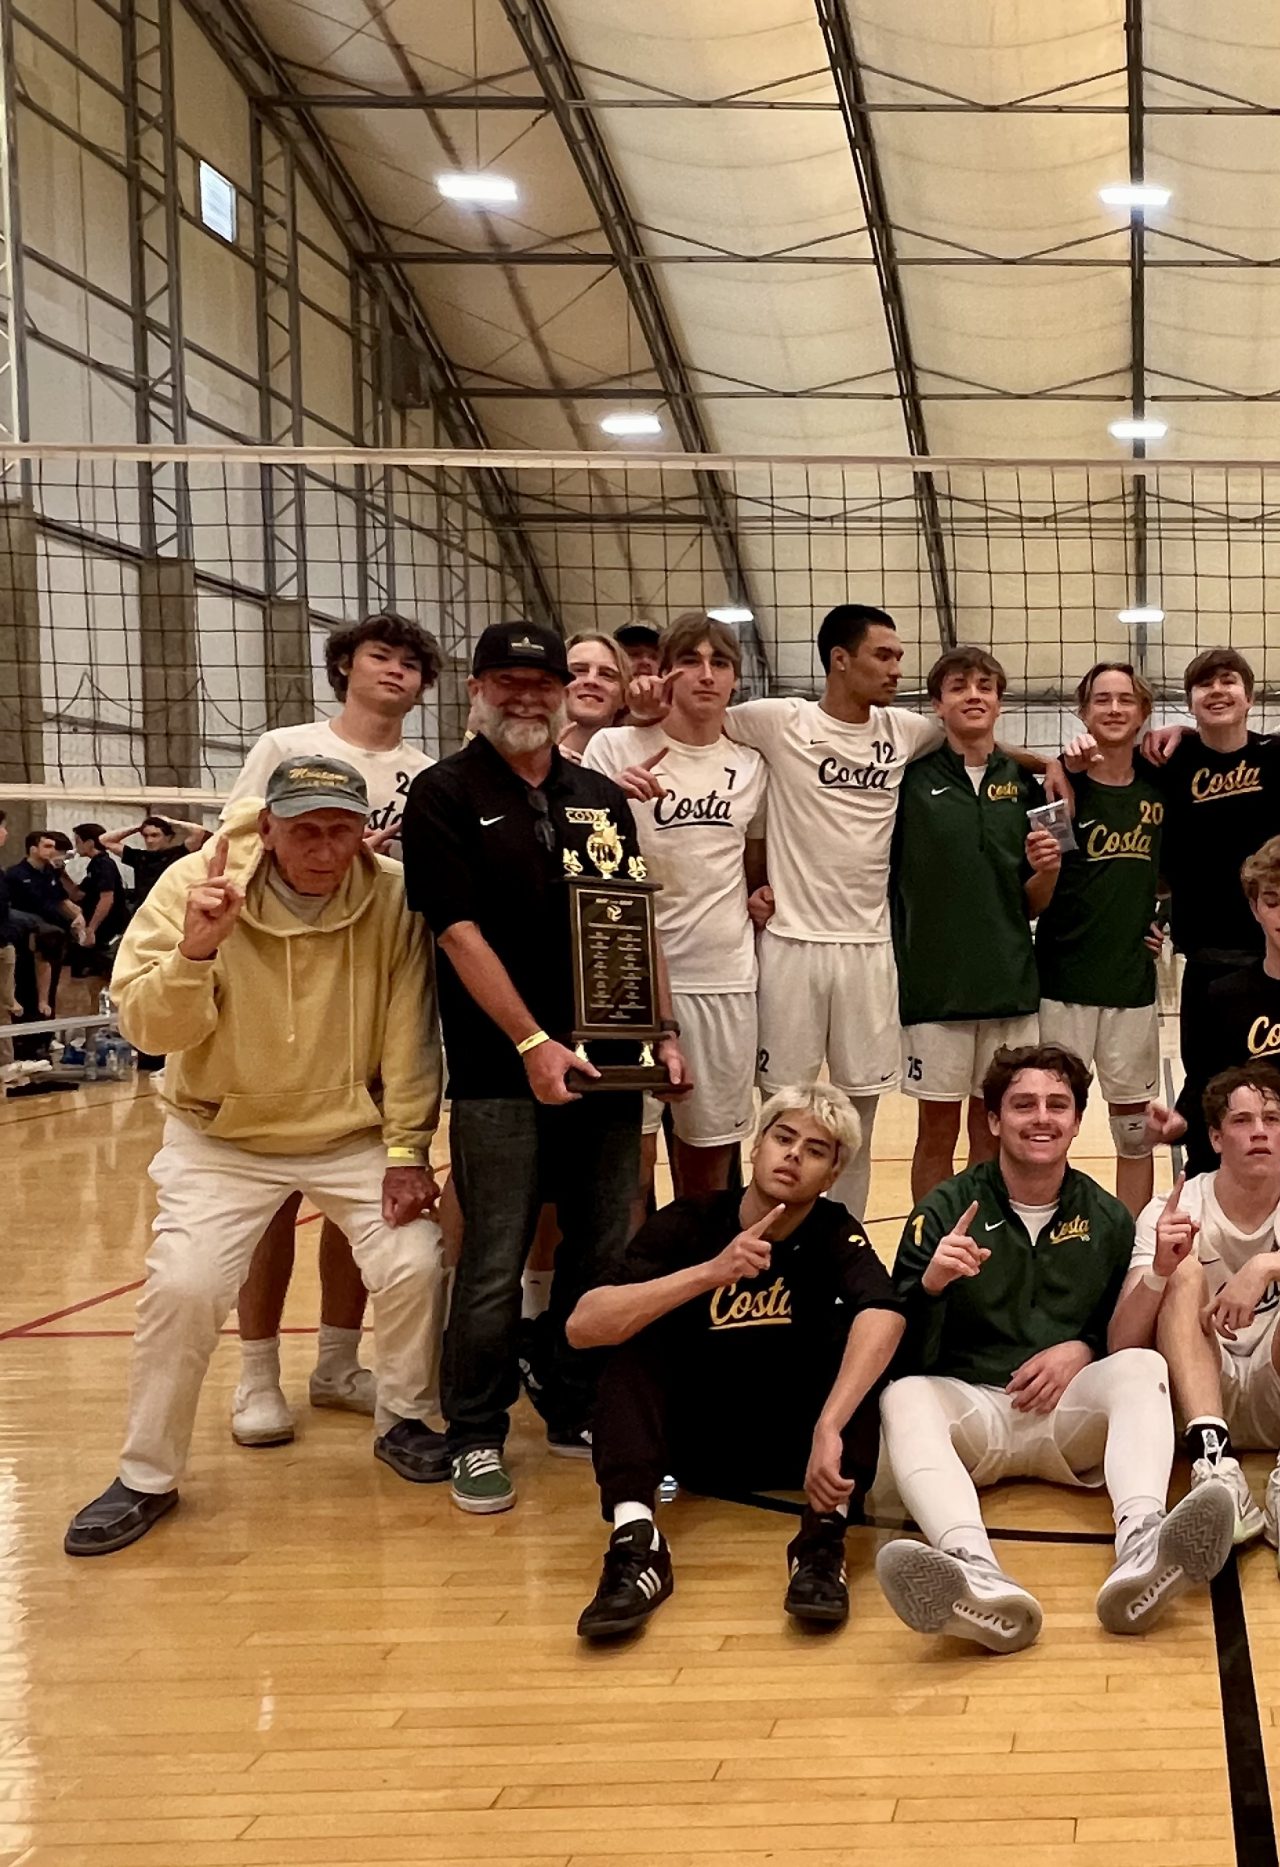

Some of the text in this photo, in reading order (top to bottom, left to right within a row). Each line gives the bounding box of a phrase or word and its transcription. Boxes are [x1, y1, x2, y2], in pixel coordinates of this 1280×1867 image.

[871, 740, 897, 764] 12
[724, 767, 737, 790] 7
[818, 757, 890, 789] Costa
[1191, 760, 1261, 800] Costa
[653, 789, 732, 828] Costa
[1140, 800, 1164, 825] 20
[1087, 824, 1152, 860] Costa
[912, 1214, 925, 1247] 1
